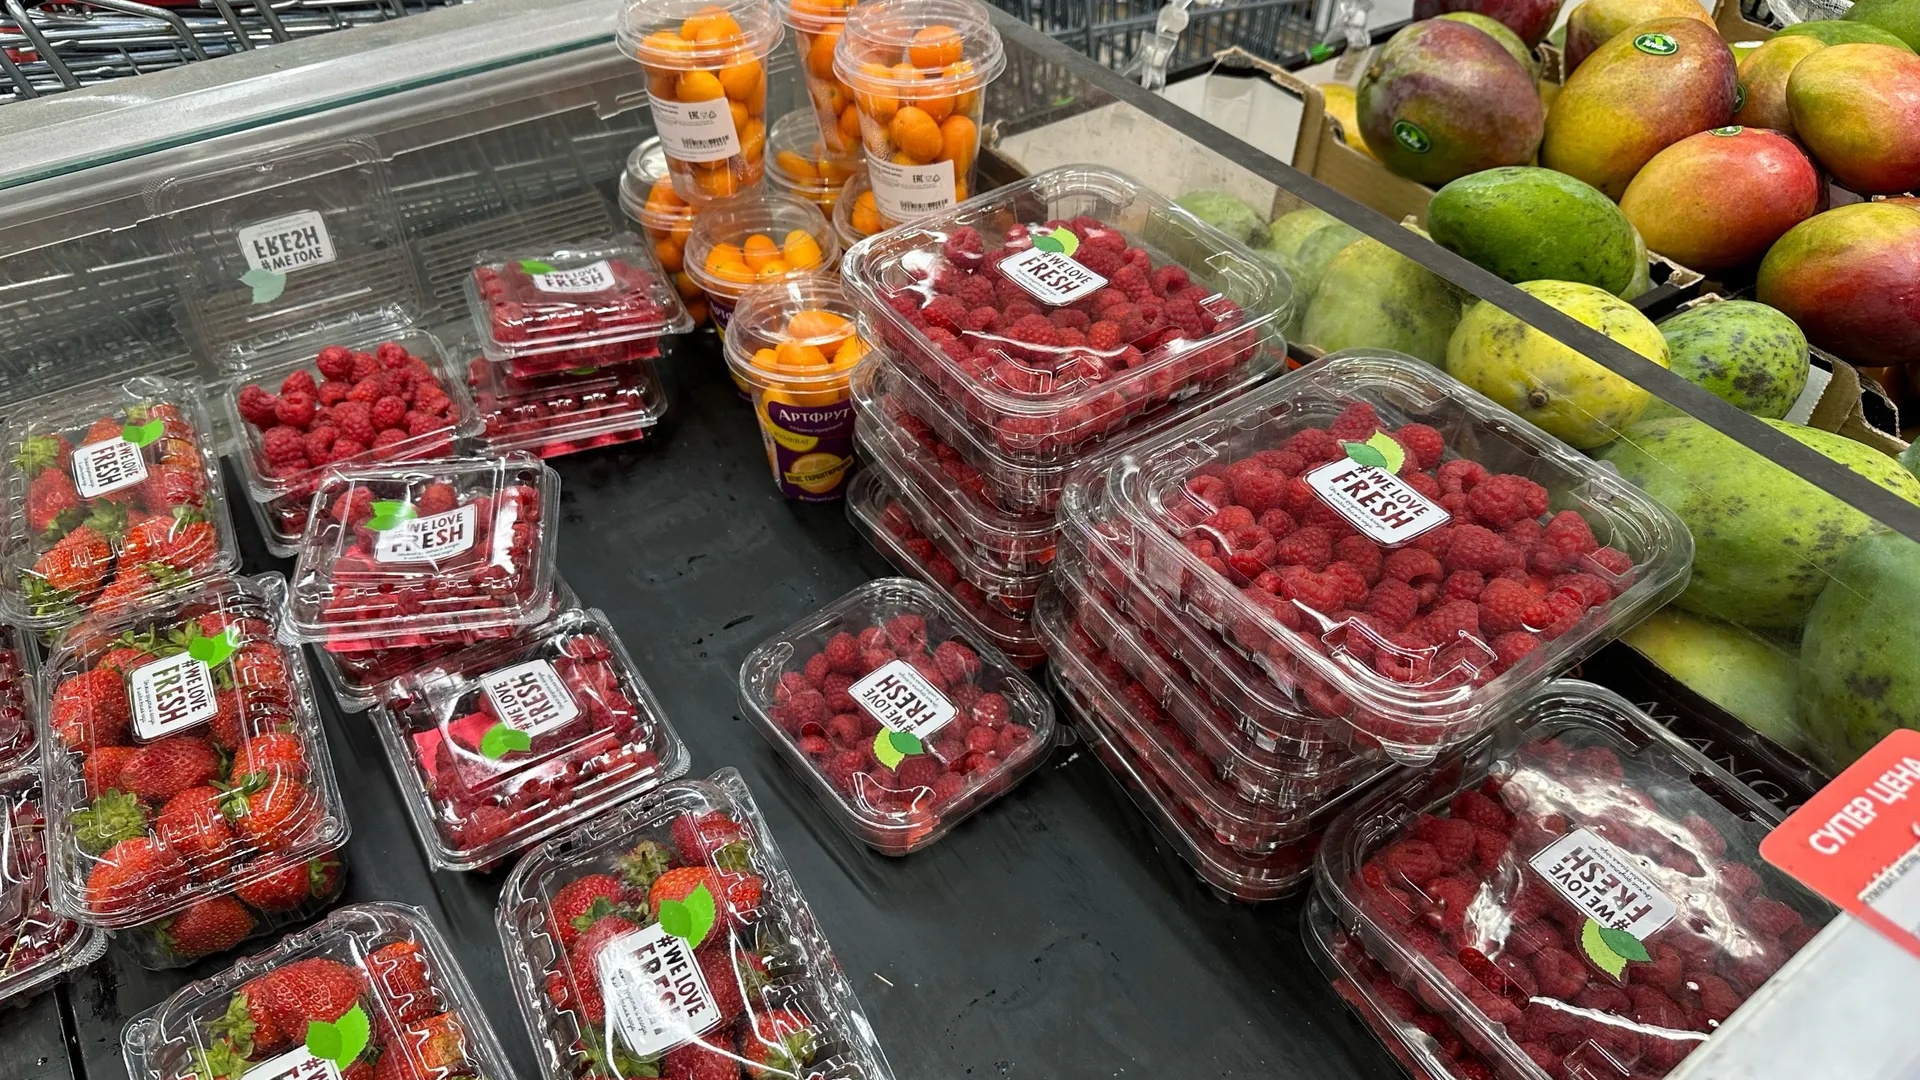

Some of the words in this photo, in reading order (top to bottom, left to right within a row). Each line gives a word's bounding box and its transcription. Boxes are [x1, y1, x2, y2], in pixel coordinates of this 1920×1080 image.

[545, 272, 605, 288] FRESH
[1019, 256, 1081, 295] FRESH
[1064, 266, 1093, 285] LOVE
[91, 444, 122, 488] FRESH
[121, 457, 139, 478] LOVE
[1330, 470, 1415, 530] FRESH
[1389, 488, 1430, 517] LOVE
[432, 512, 463, 530] LOVE
[152, 664, 189, 725] FRESH
[187, 683, 208, 712] LOVE
[493, 681, 519, 709] LOVE
[509, 671, 560, 726] FRESH
[862, 688, 892, 714] LOVE
[875, 674, 937, 727] FRESH
[1635, 701, 1801, 815] MANG
[1808, 796, 1878, 856] СУПЕР
[1865, 756, 1920, 805] ЦЕНА
[1548, 862, 1591, 899] LOVE
[1560, 846, 1653, 923] FRESH
[656, 934, 688, 976] #WE
[674, 972, 706, 1018] LOVE
[300, 1057, 329, 1080] #W
